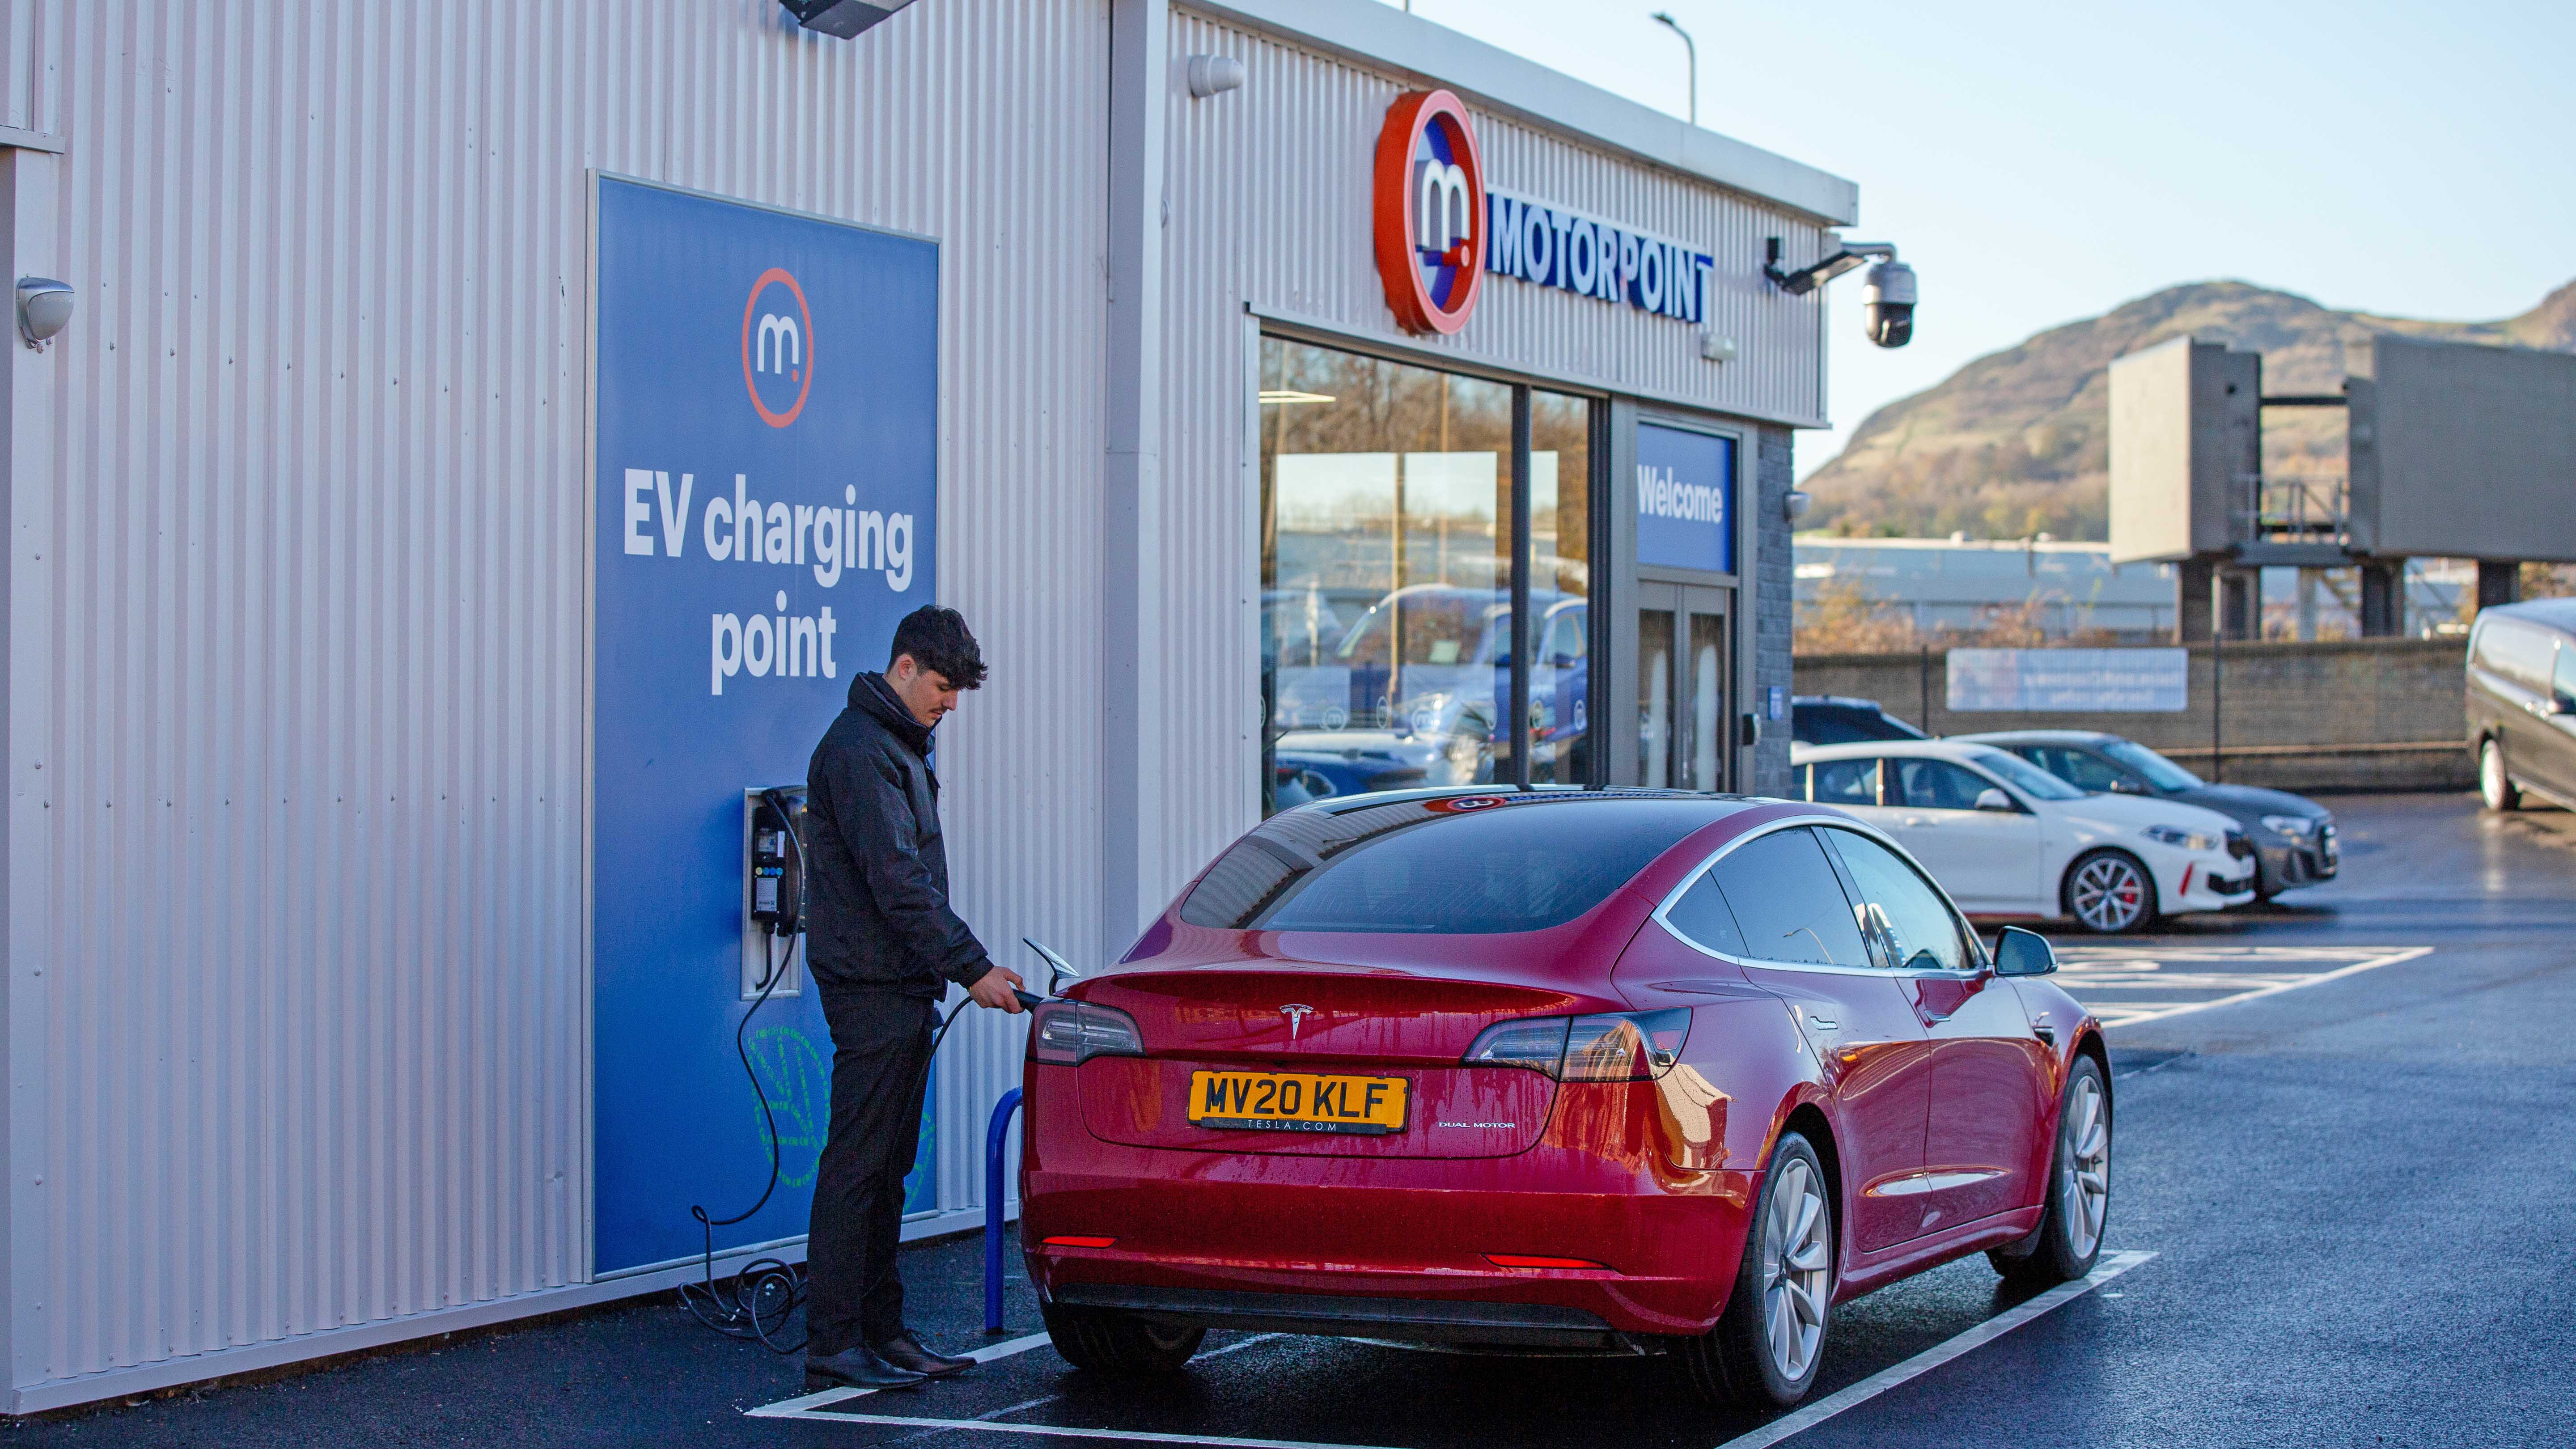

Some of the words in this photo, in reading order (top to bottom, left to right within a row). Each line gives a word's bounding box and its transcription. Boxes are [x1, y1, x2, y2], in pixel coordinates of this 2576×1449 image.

[1492, 192, 1713, 324] MOTORPOINT
[625, 468, 694, 557] EV
[703, 474, 913, 592] charging
[1637, 464, 1722, 524] Welcome
[712, 589, 836, 695] point
[1205, 1078, 1302, 1115] MV20
[1313, 1081, 1389, 1118] KLF
[1248, 1119, 1337, 1131] TESLA.COM
